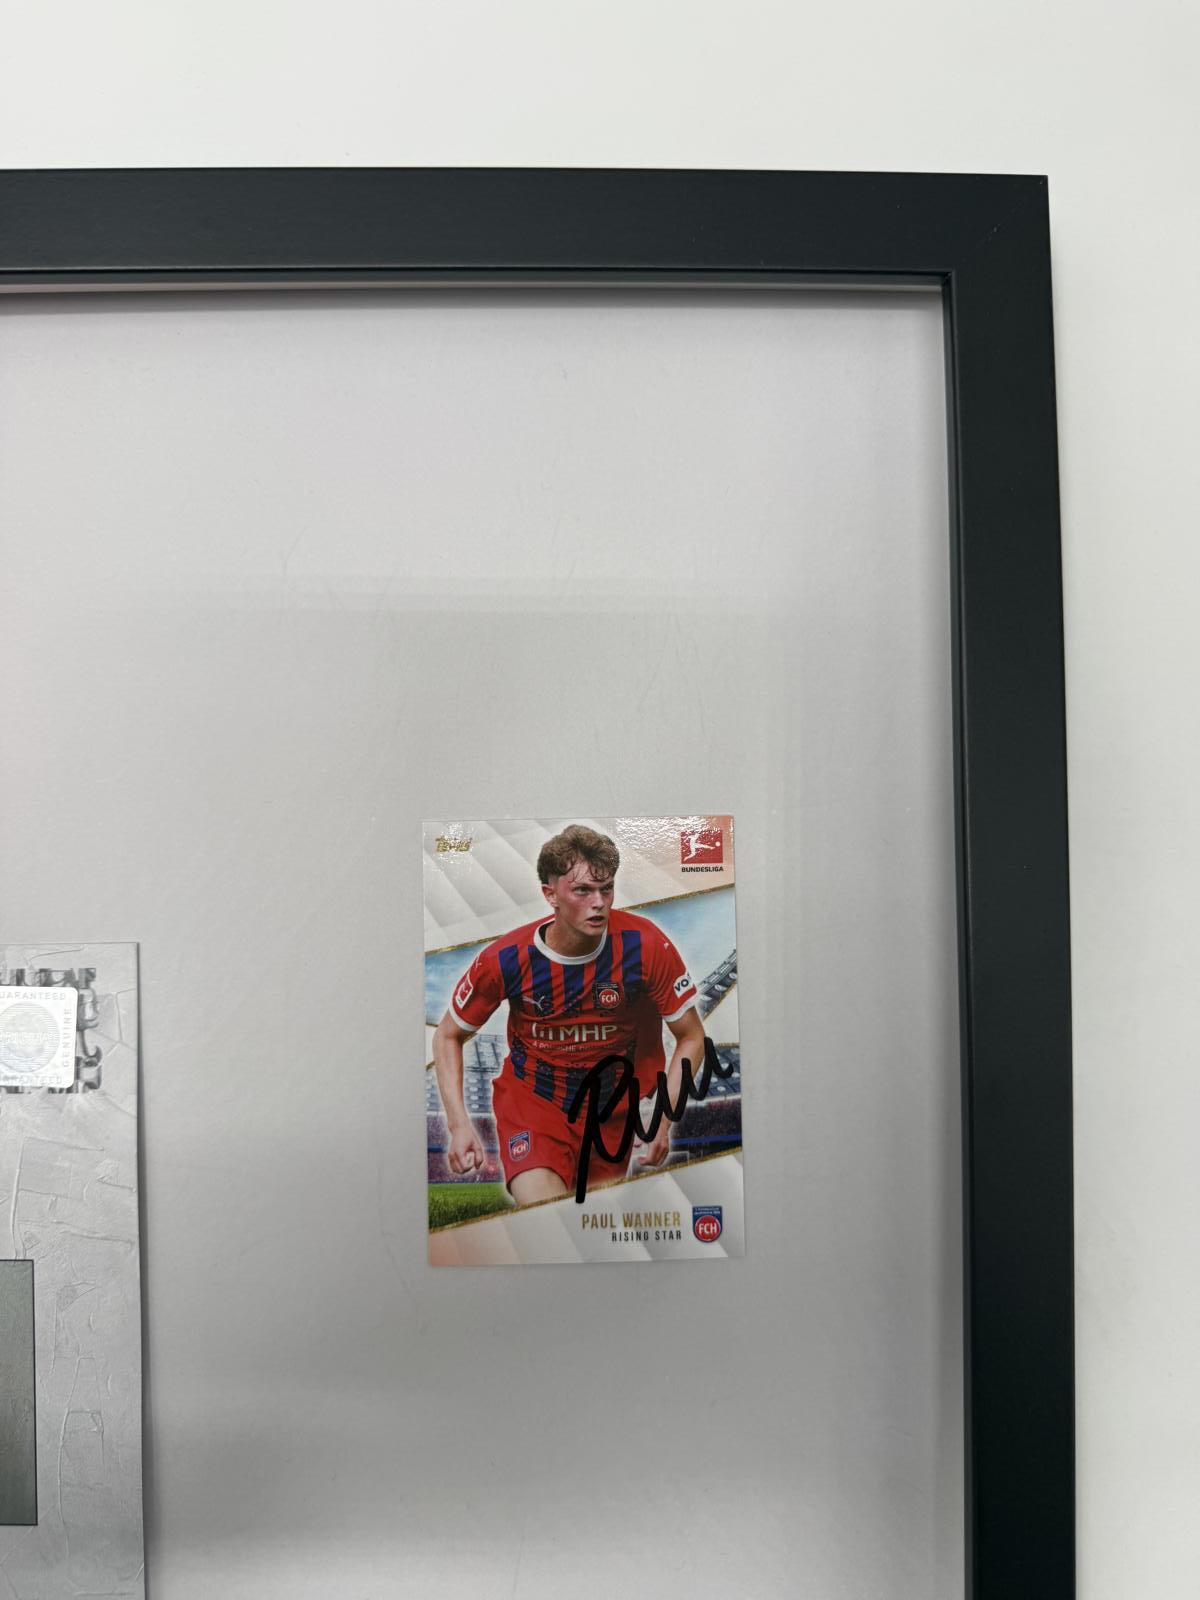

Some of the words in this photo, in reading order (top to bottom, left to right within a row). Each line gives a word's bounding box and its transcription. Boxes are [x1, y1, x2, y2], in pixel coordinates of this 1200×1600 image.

[63, 1007, 72, 1068] GENUINE
[559, 1024, 618, 1042] MHP
[581, 1213, 617, 1230] PAUL
[622, 1210, 681, 1229] WANNER
[698, 1222, 718, 1235] FCH
[611, 1231, 650, 1243] RISING
[655, 1230, 682, 1241] STAR
